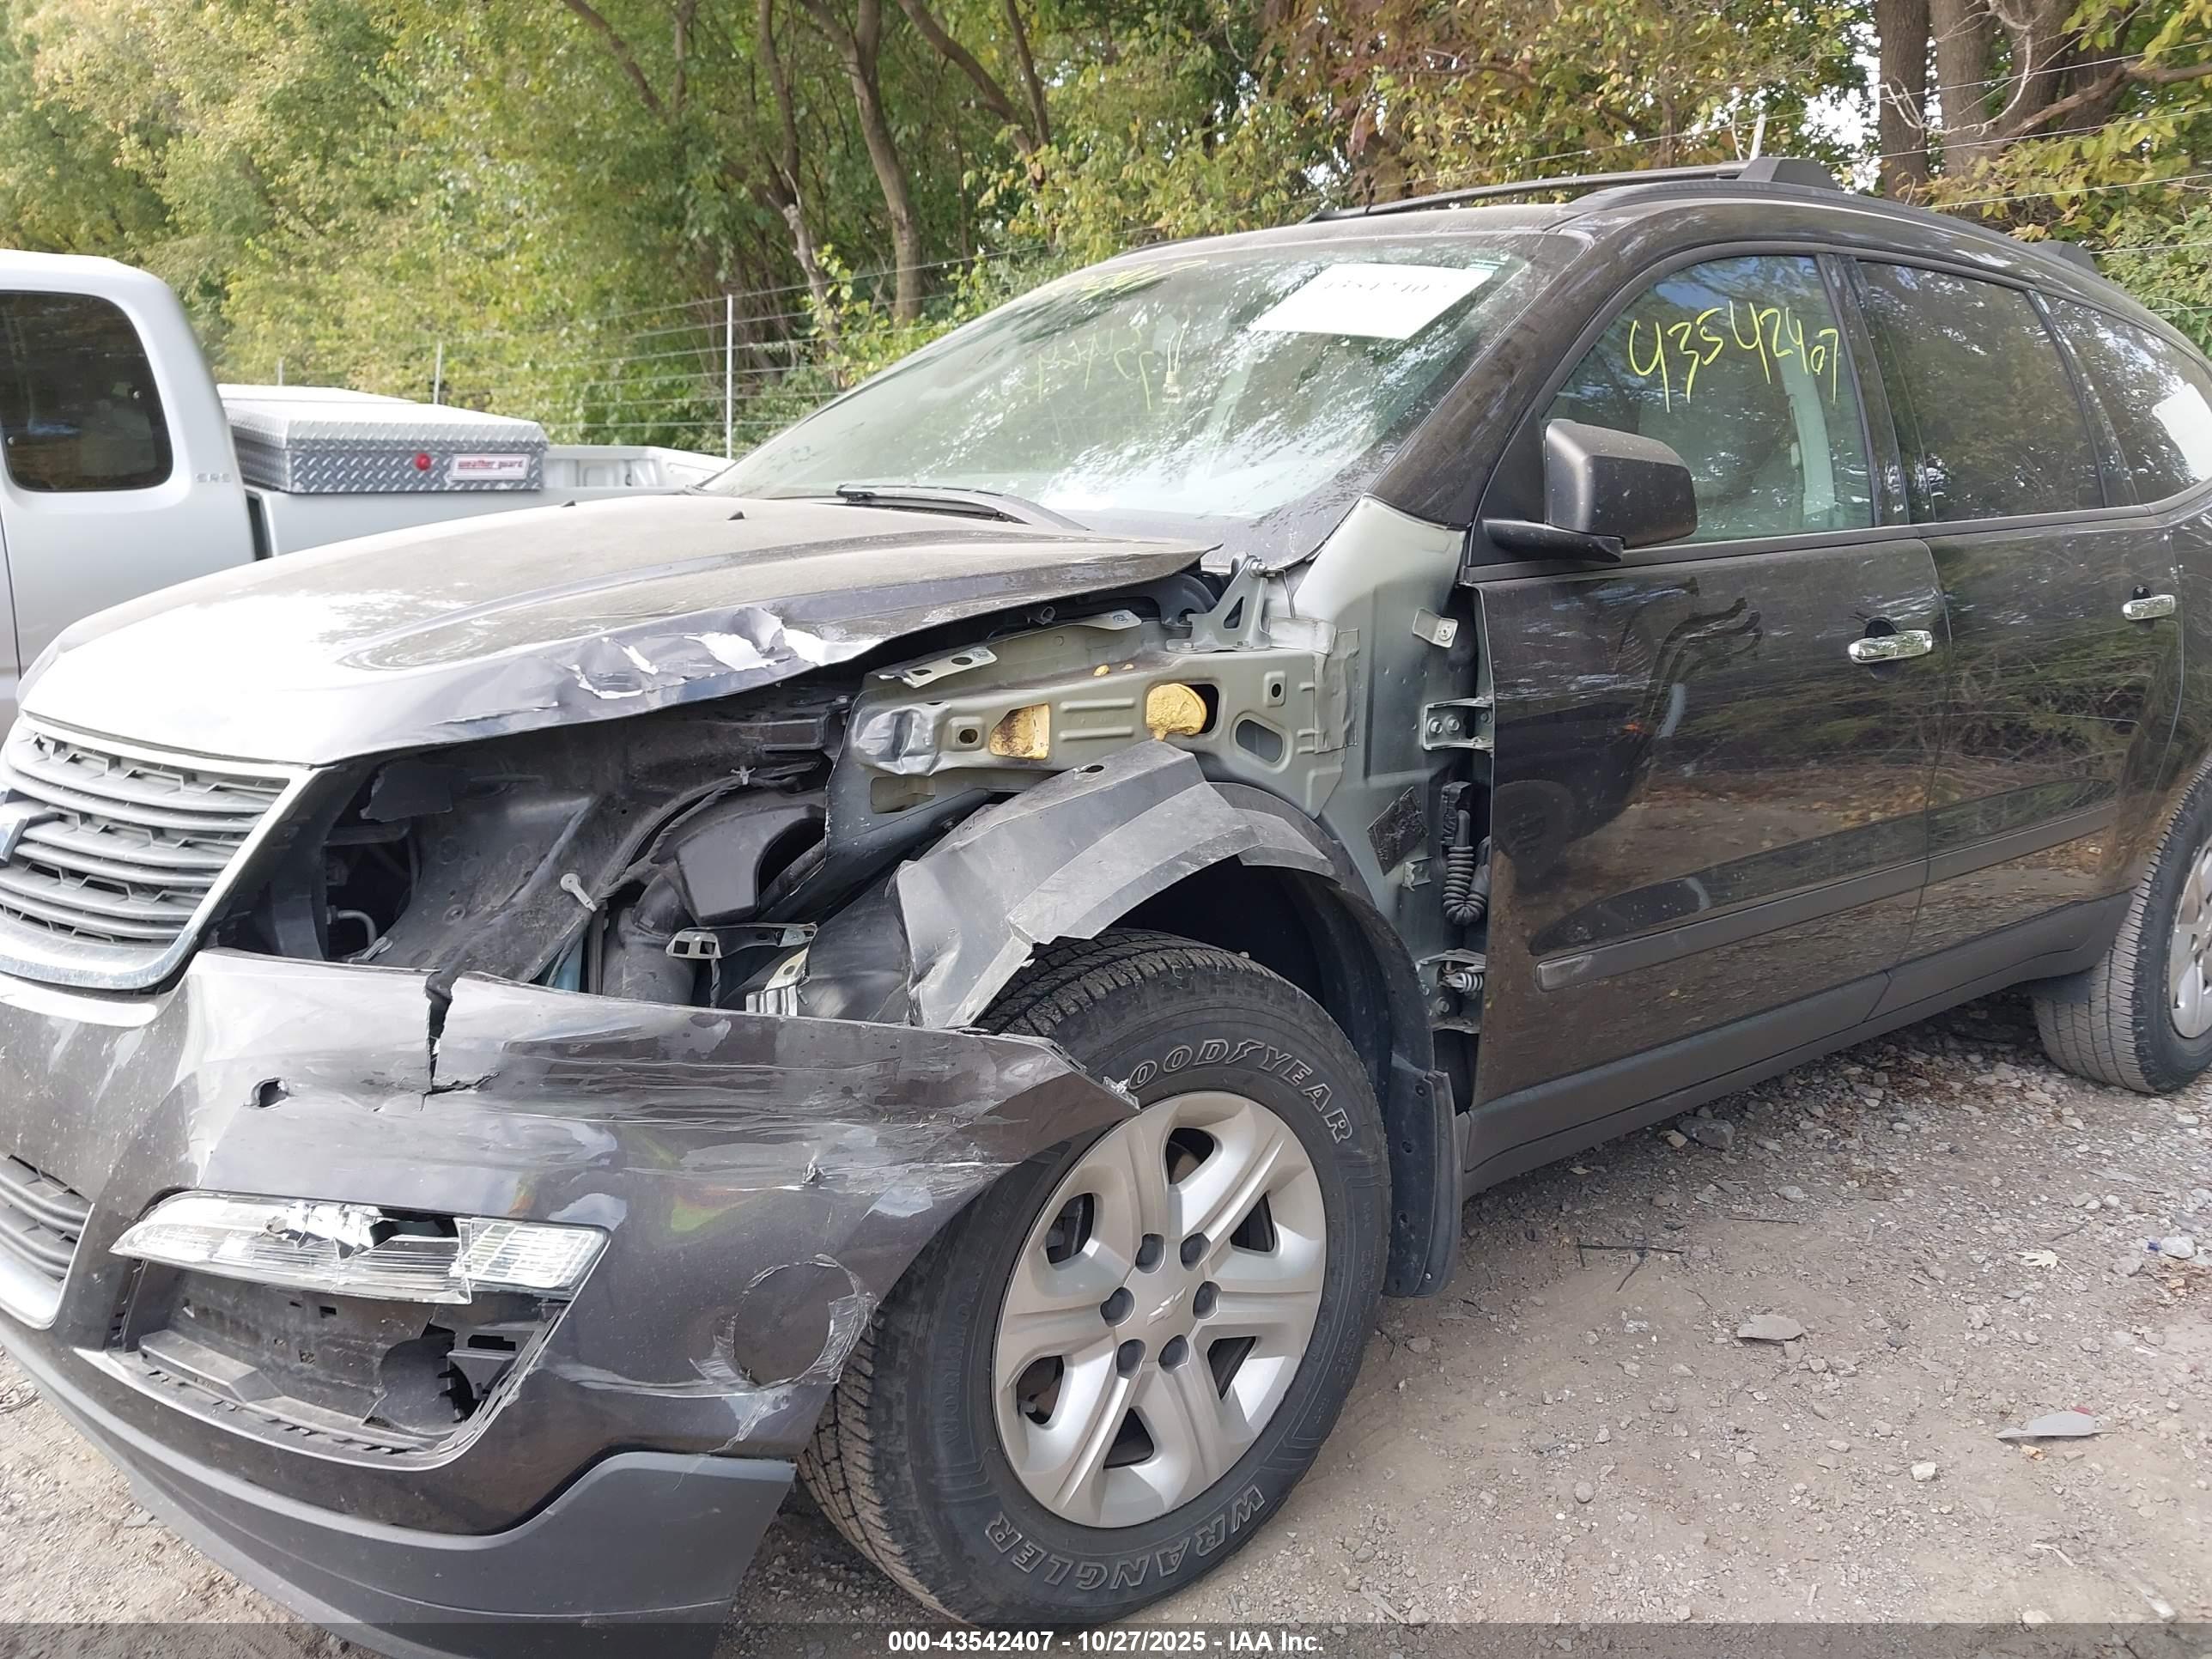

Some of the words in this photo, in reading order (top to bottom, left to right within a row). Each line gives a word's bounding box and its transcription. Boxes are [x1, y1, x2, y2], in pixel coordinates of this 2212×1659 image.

[498, 460, 524, 469] guard
[1127, 1038, 1354, 1145] OODYEAR
[984, 1484, 1266, 1590] WRANGLER
